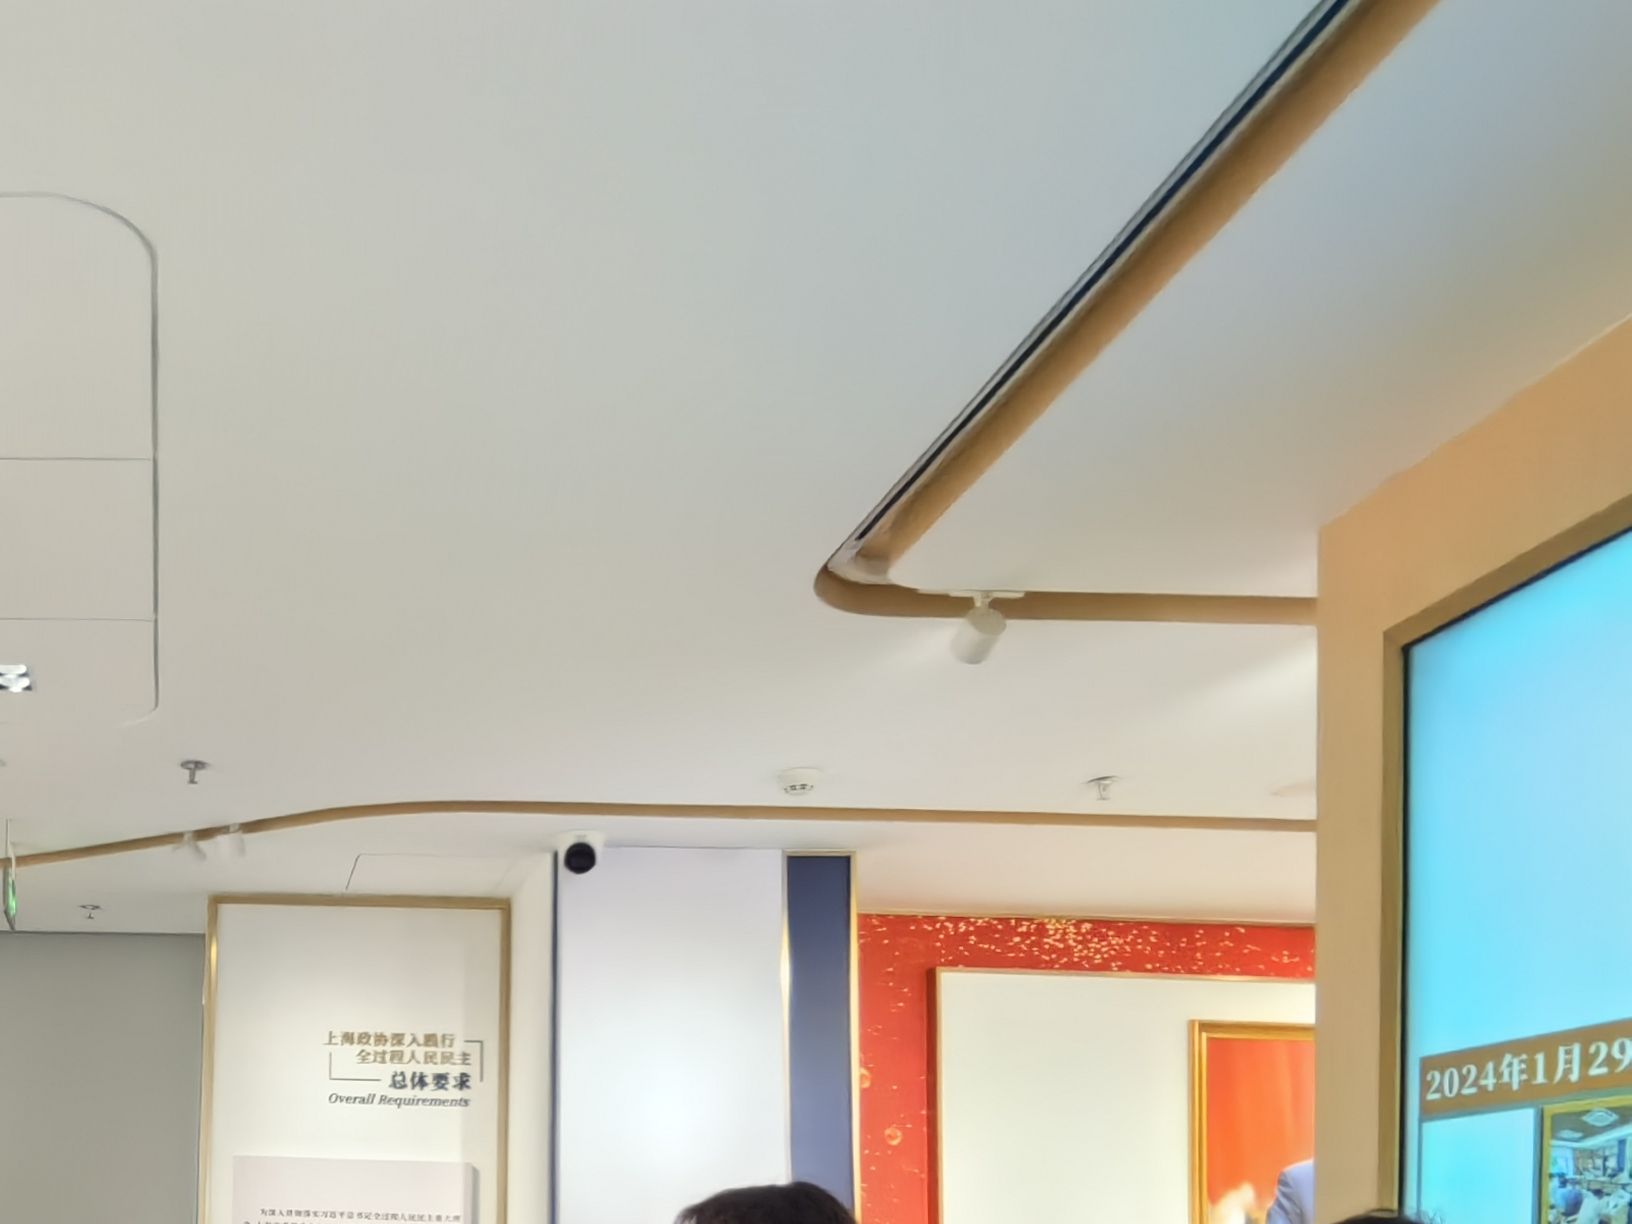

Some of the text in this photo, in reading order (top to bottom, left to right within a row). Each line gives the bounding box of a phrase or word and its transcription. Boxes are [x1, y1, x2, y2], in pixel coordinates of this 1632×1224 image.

[323, 1031, 456, 1048] 上海政协深入践行
[356, 1049, 472, 1066] 全过程人民民主
[1426, 1037, 1632, 1100] 2024年1月29
[389, 1070, 472, 1091] 总体要求
[328, 1093, 471, 1109] Overall Requirements
